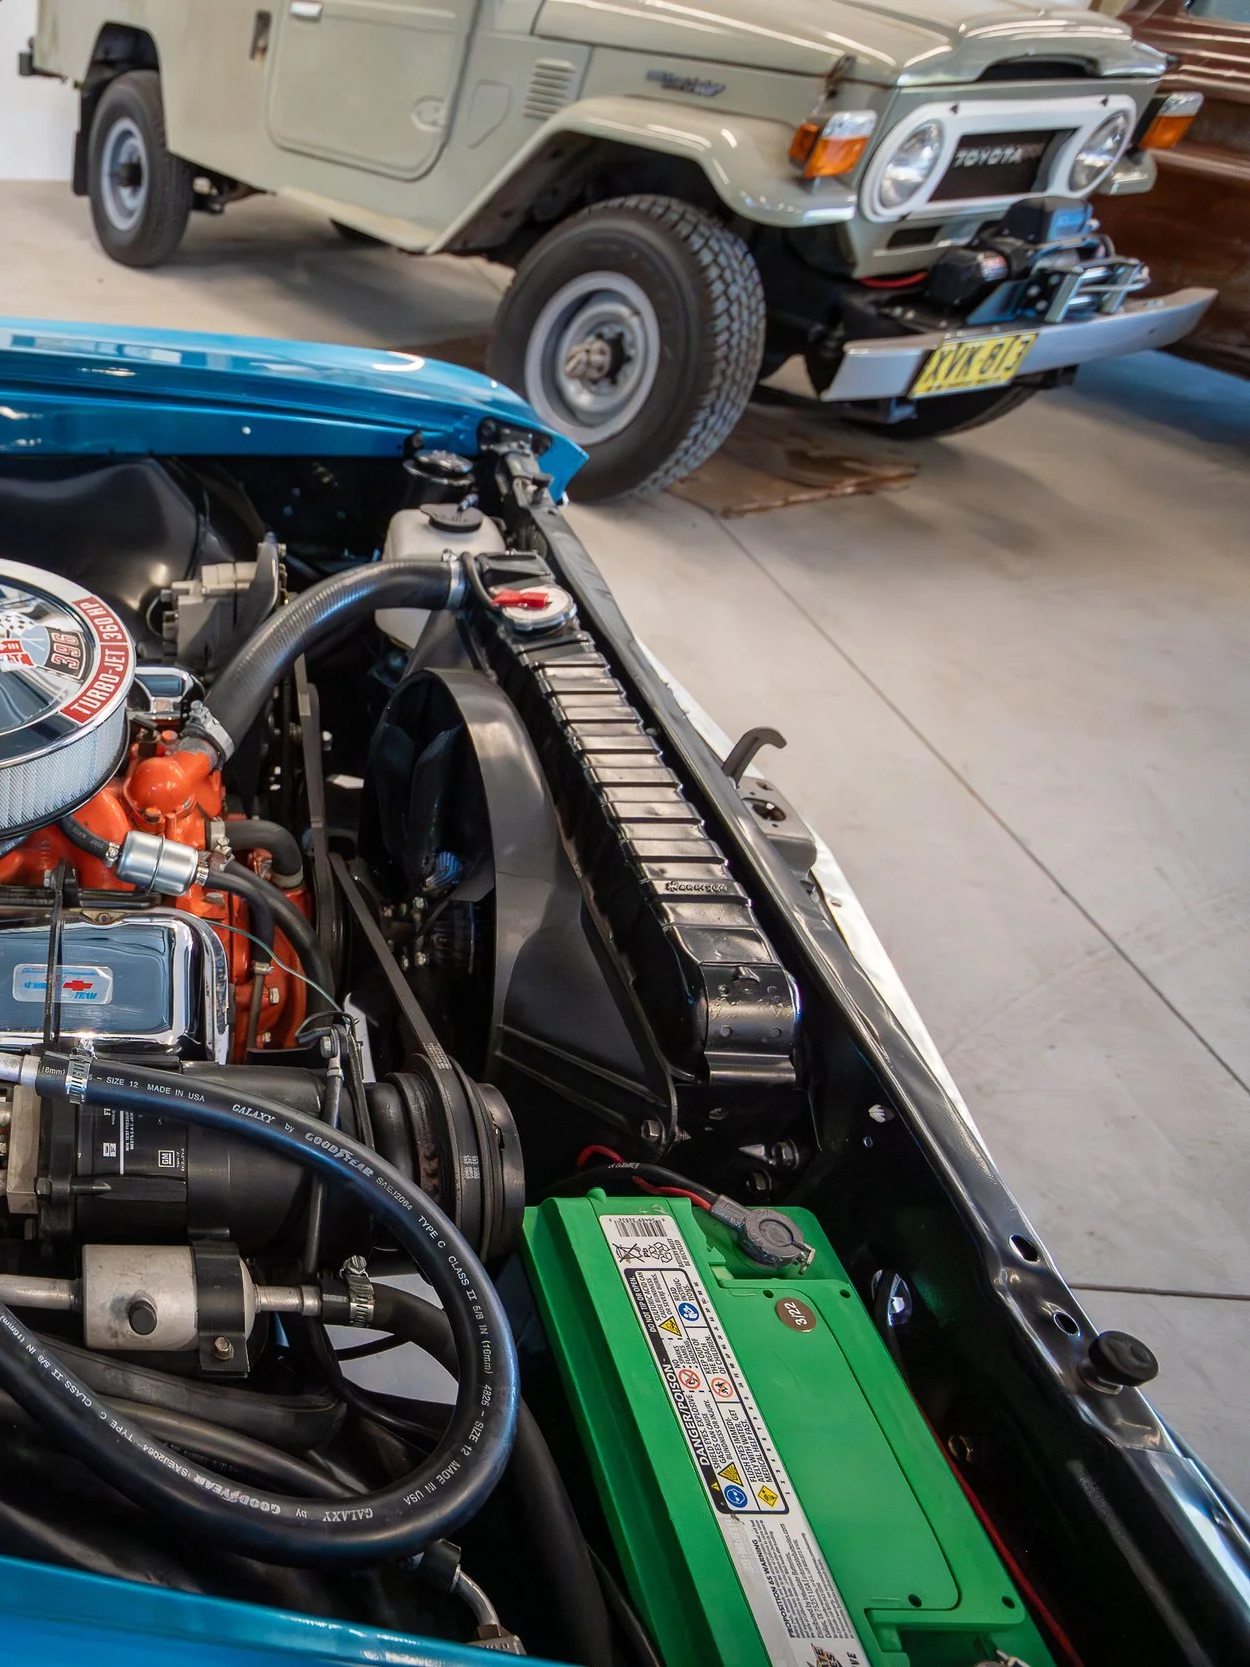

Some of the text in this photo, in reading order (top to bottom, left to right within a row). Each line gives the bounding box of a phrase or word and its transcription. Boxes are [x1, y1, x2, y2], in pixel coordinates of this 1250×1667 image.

[954, 145, 1022, 167] TOYOTA
[51, 631, 80, 670] 396
[70, 601, 126, 714] TURBO-JET 360 HP
[106, 1076, 125, 1086] SIZE
[129, 1080, 139, 1089] 12
[147, 1083, 171, 1095] MADE
[175, 1089, 184, 1097] IN
[188, 1092, 205, 1102] USA
[231, 1103, 276, 1124] GALAXY
[284, 1121, 295, 1133] by
[161, 1152, 169, 1164] GM
[305, 1132, 374, 1178] GOODYEAR
[417, 1215, 439, 1239] TYPE
[437, 1240, 446, 1249] C
[448, 1255, 470, 1286] CLASS
[466, 1289, 478, 1302] II
[636, 1271, 661, 1320] SULFURIC ACID CAN
[669, 1286, 681, 1301] READ
[642, 1310, 652, 1322] NOT
[783, 1301, 808, 1326] 3/22
[0, 1315, 26, 1343] (16mm)
[479, 1324, 489, 1335] IN
[647, 1323, 656, 1332] DO
[25, 1344, 36, 1355] IN
[481, 1340, 493, 1374] (16mm)
[673, 1345, 685, 1364] SPARKS
[679, 1345, 691, 1364] FLAMES
[691, 1337, 711, 1373] KEEP OUT OF
[700, 1342, 719, 1373] THE REACH
[671, 1359, 680, 1368] NO
[717, 1365, 726, 1374] OF
[51, 1369, 64, 1381] II
[64, 1380, 92, 1407] CLASS
[481, 1384, 493, 1407] 4826
[99, 1411, 107, 1420] C
[661, 1363, 710, 1465] DANGER/POISON
[685, 1394, 704, 1426] EXPLOSIVE
[728, 1408, 739, 1420] GET
[109, 1419, 134, 1443] TYPE
[468, 1420, 484, 1443] SIZE
[700, 1412, 726, 1463] GASES CAN CAUSE
[461, 1445, 472, 1456] 12
[735, 1444, 748, 1460] EYES
[744, 1446, 756, 1462] WITH
[747, 1435, 760, 1452] HELP
[706, 1446, 721, 1469] SHIELD
[754, 1452, 772, 1482] MEDICAL
[436, 1460, 461, 1485] MADE
[742, 1461, 757, 1482] FLUSH
[750, 1461, 765, 1483] ATELY
[193, 1473, 281, 1515] GOODYEAR
[403, 1490, 424, 1506] USA
[425, 1482, 437, 1494] IN
[295, 1508, 308, 1519] by
[322, 1507, 374, 1522] GALAXY
[751, 1538, 796, 1638] PROPOSITION 65 WARNING
